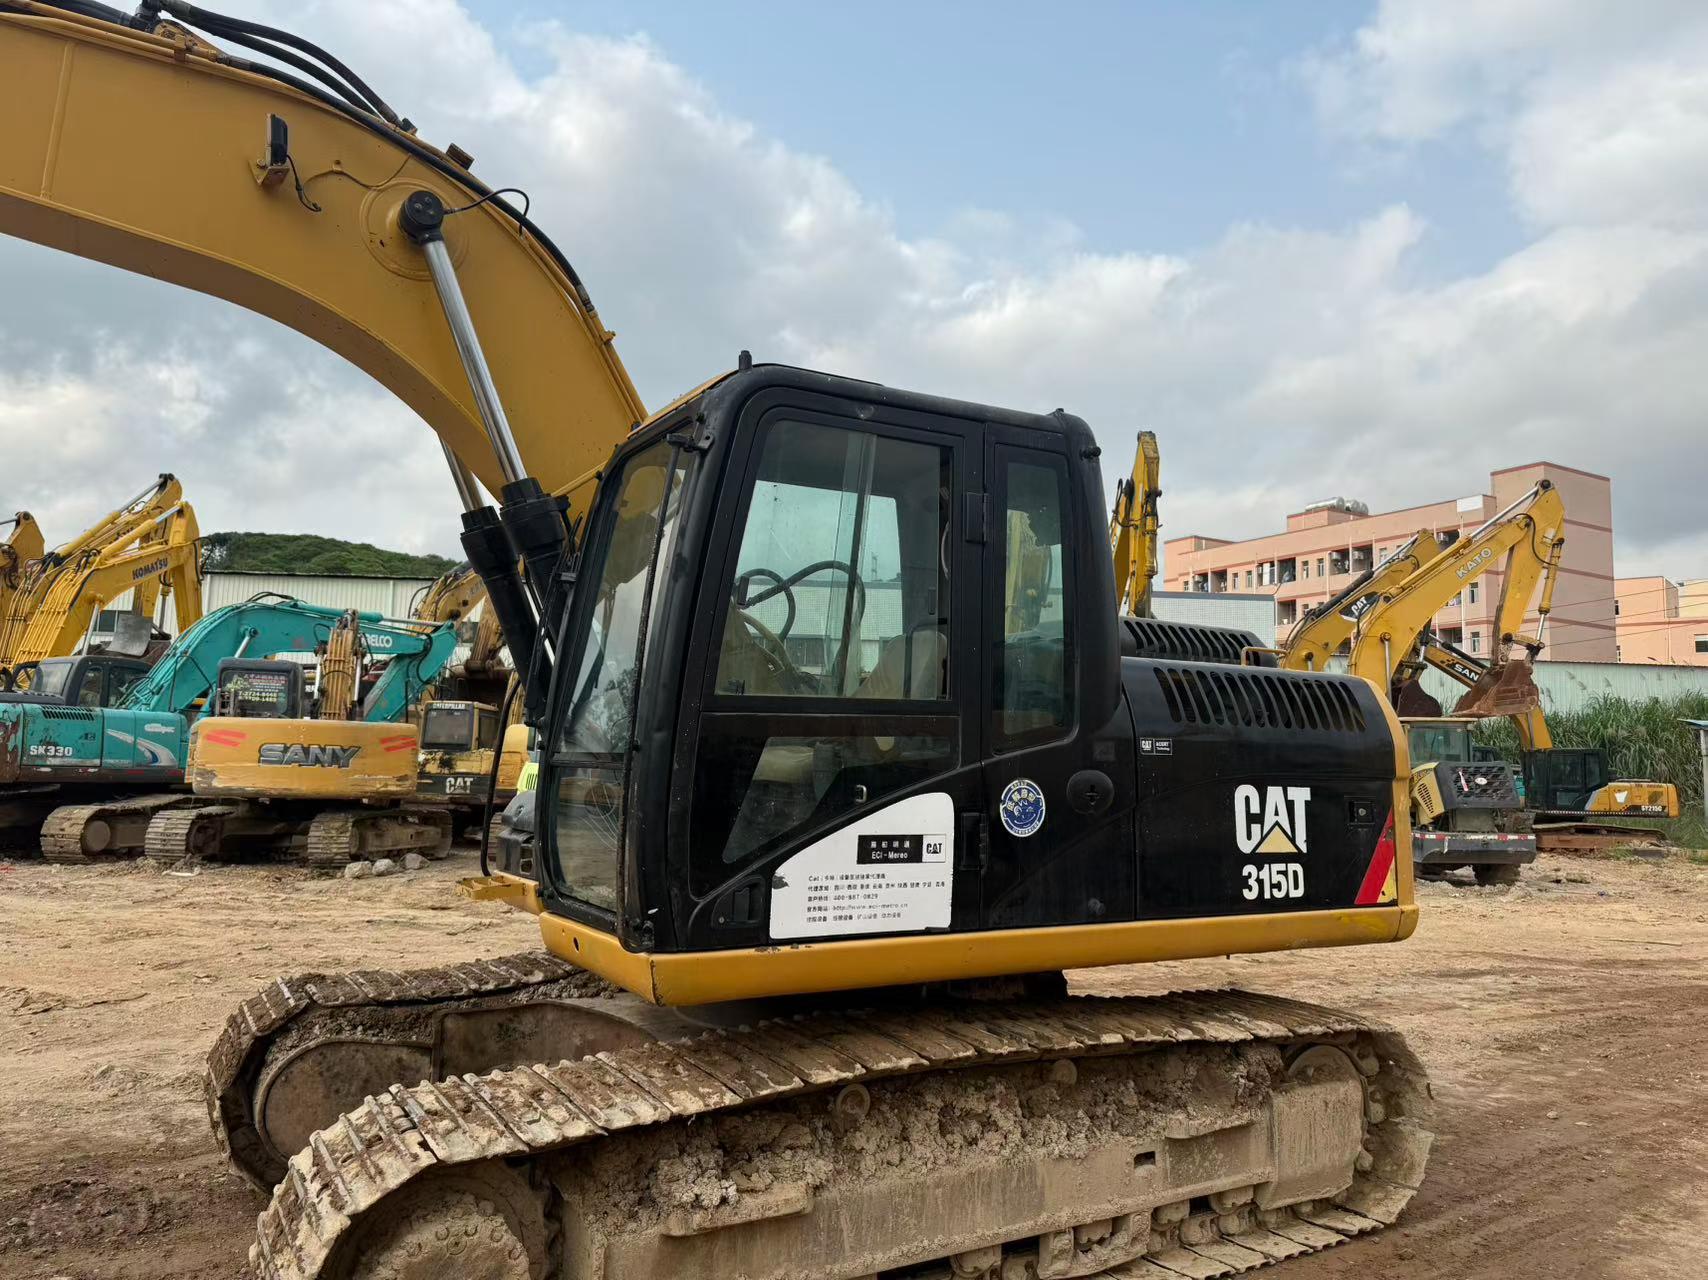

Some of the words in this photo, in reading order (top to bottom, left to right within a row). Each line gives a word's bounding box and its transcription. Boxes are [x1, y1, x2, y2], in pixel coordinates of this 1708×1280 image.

[132, 557, 169, 581] KOMATSU
[1455, 547, 1493, 580] KATO
[1351, 596, 1368, 616] CAT
[1453, 662, 1480, 683] SAN
[29, 745, 73, 757] SK330
[258, 742, 361, 769] SANY
[445, 777, 474, 794] CAT
[1234, 784, 1311, 854] CAT
[926, 842, 943, 855] CAT
[1242, 863, 1305, 900] 315D
